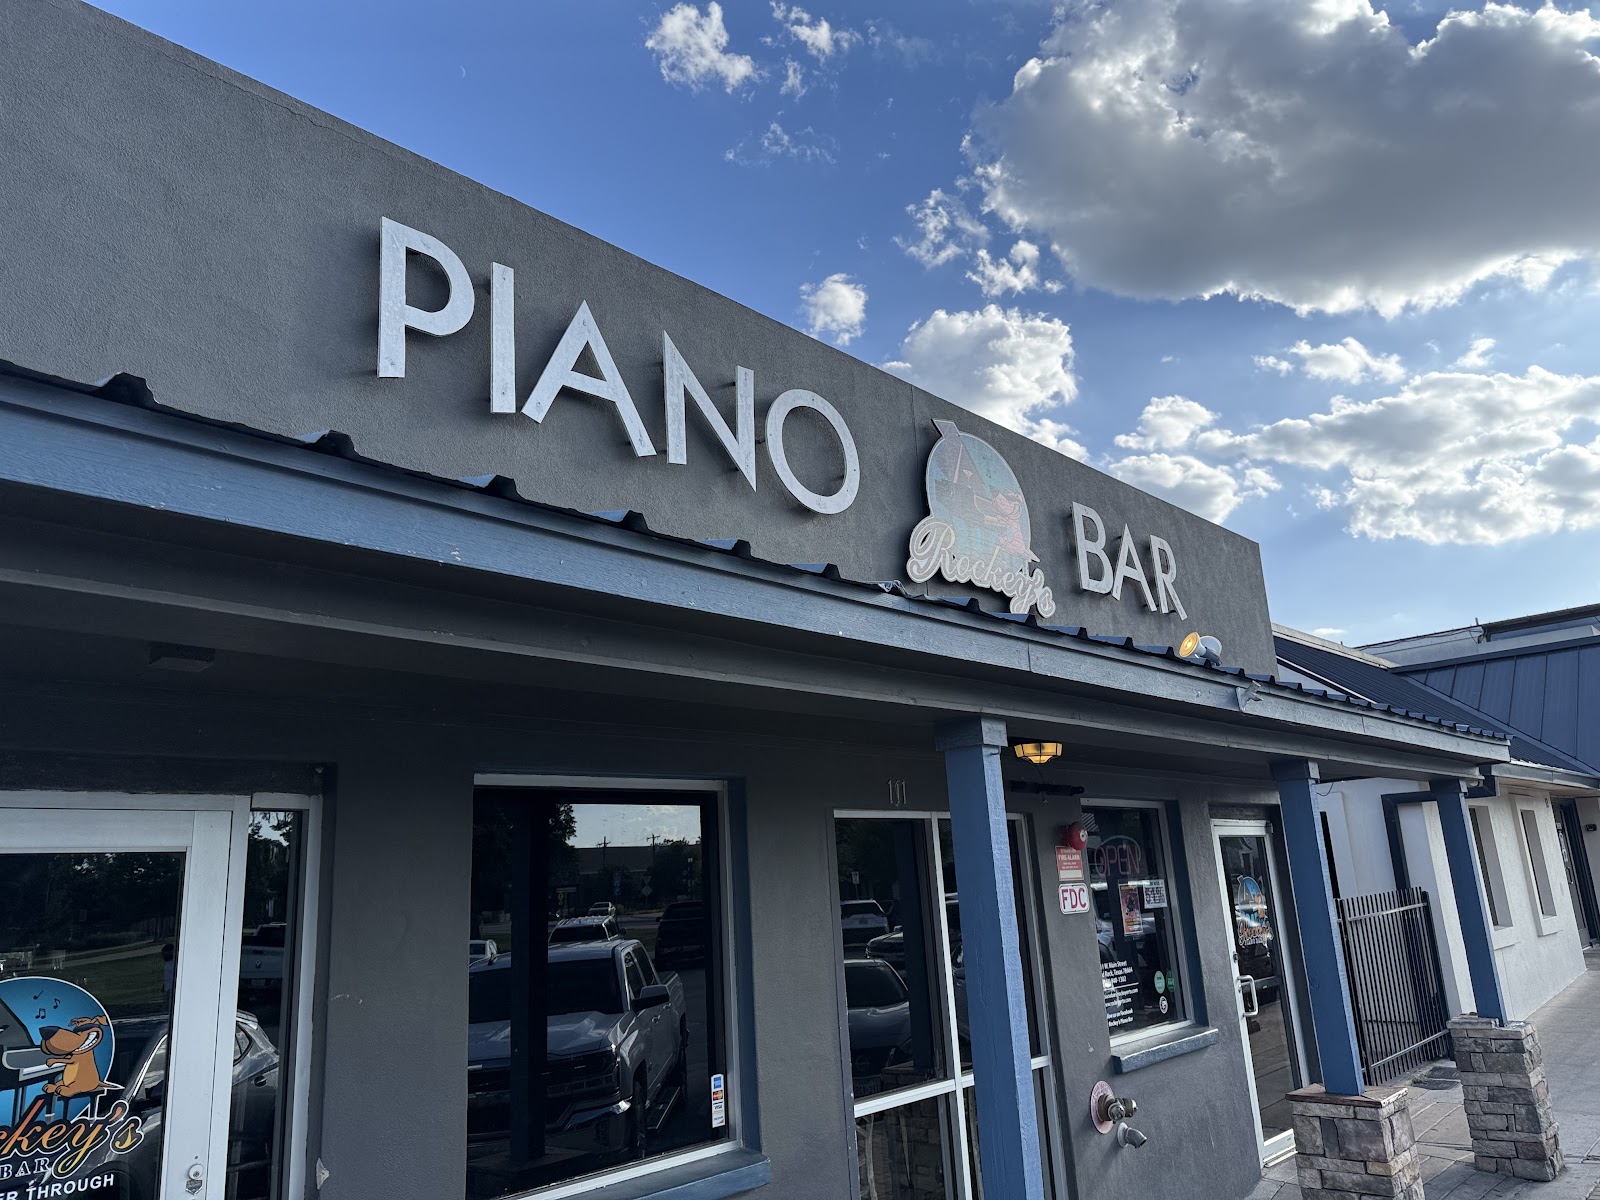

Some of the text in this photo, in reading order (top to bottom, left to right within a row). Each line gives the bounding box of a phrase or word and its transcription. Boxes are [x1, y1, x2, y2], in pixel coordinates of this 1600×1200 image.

[377, 216, 860, 515] PIANO
[908, 518, 1056, 618] Rockey's
[1071, 501, 1188, 621] BAR
[1094, 845, 1141, 876] OPEN
[1061, 887, 1087, 910] FDC
[0, 1157, 52, 1181] BAR
[26, 1173, 115, 1200] THROUGH
